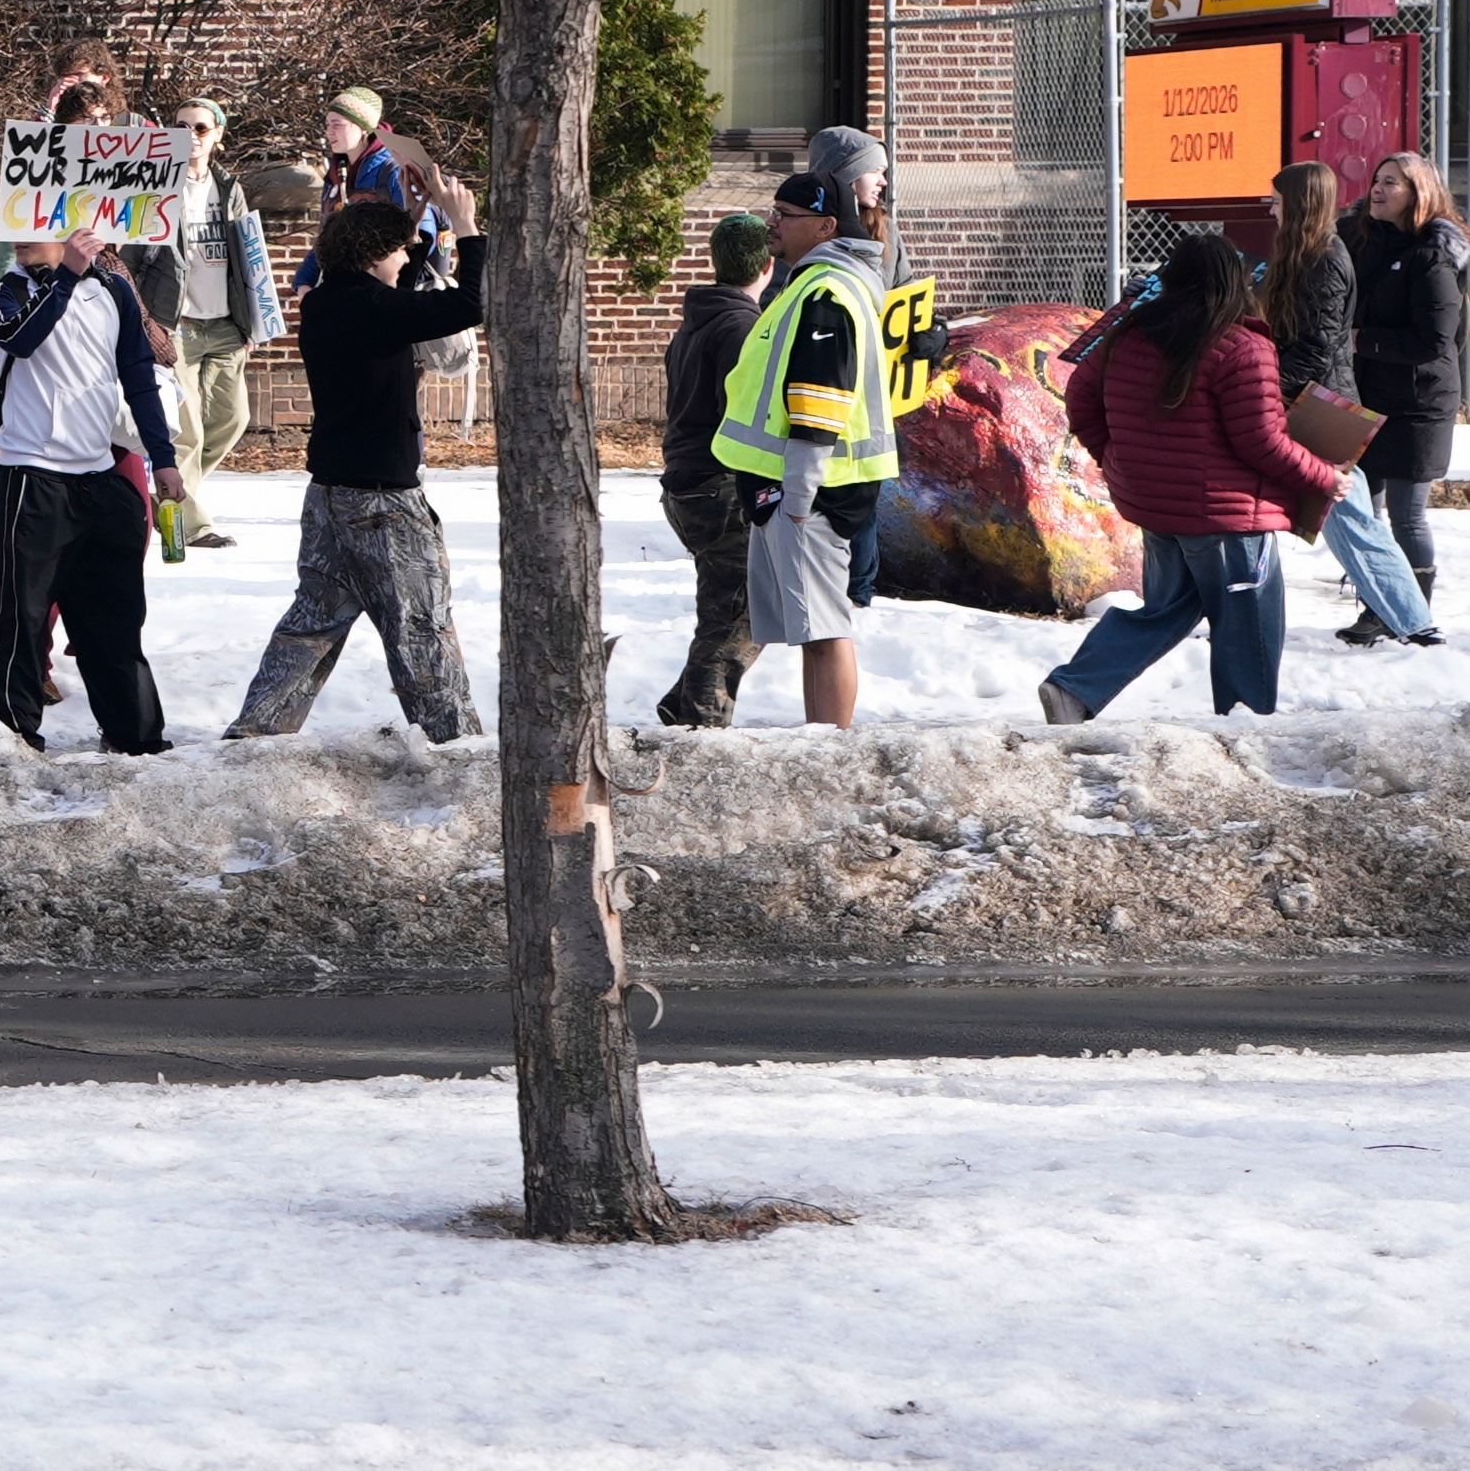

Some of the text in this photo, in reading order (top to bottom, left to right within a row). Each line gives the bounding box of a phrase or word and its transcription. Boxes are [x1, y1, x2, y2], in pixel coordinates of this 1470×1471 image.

[1163, 84, 1238, 118] 1/12/2026
[8, 125, 172, 160] WE LOVE
[1170, 131, 1234, 163] 2:00 PM
[5, 156, 69, 187] OUR
[2, 188, 179, 241] CLASSMATES
[238, 216, 281, 337] SHE WAS
[882, 290, 928, 350] CE
